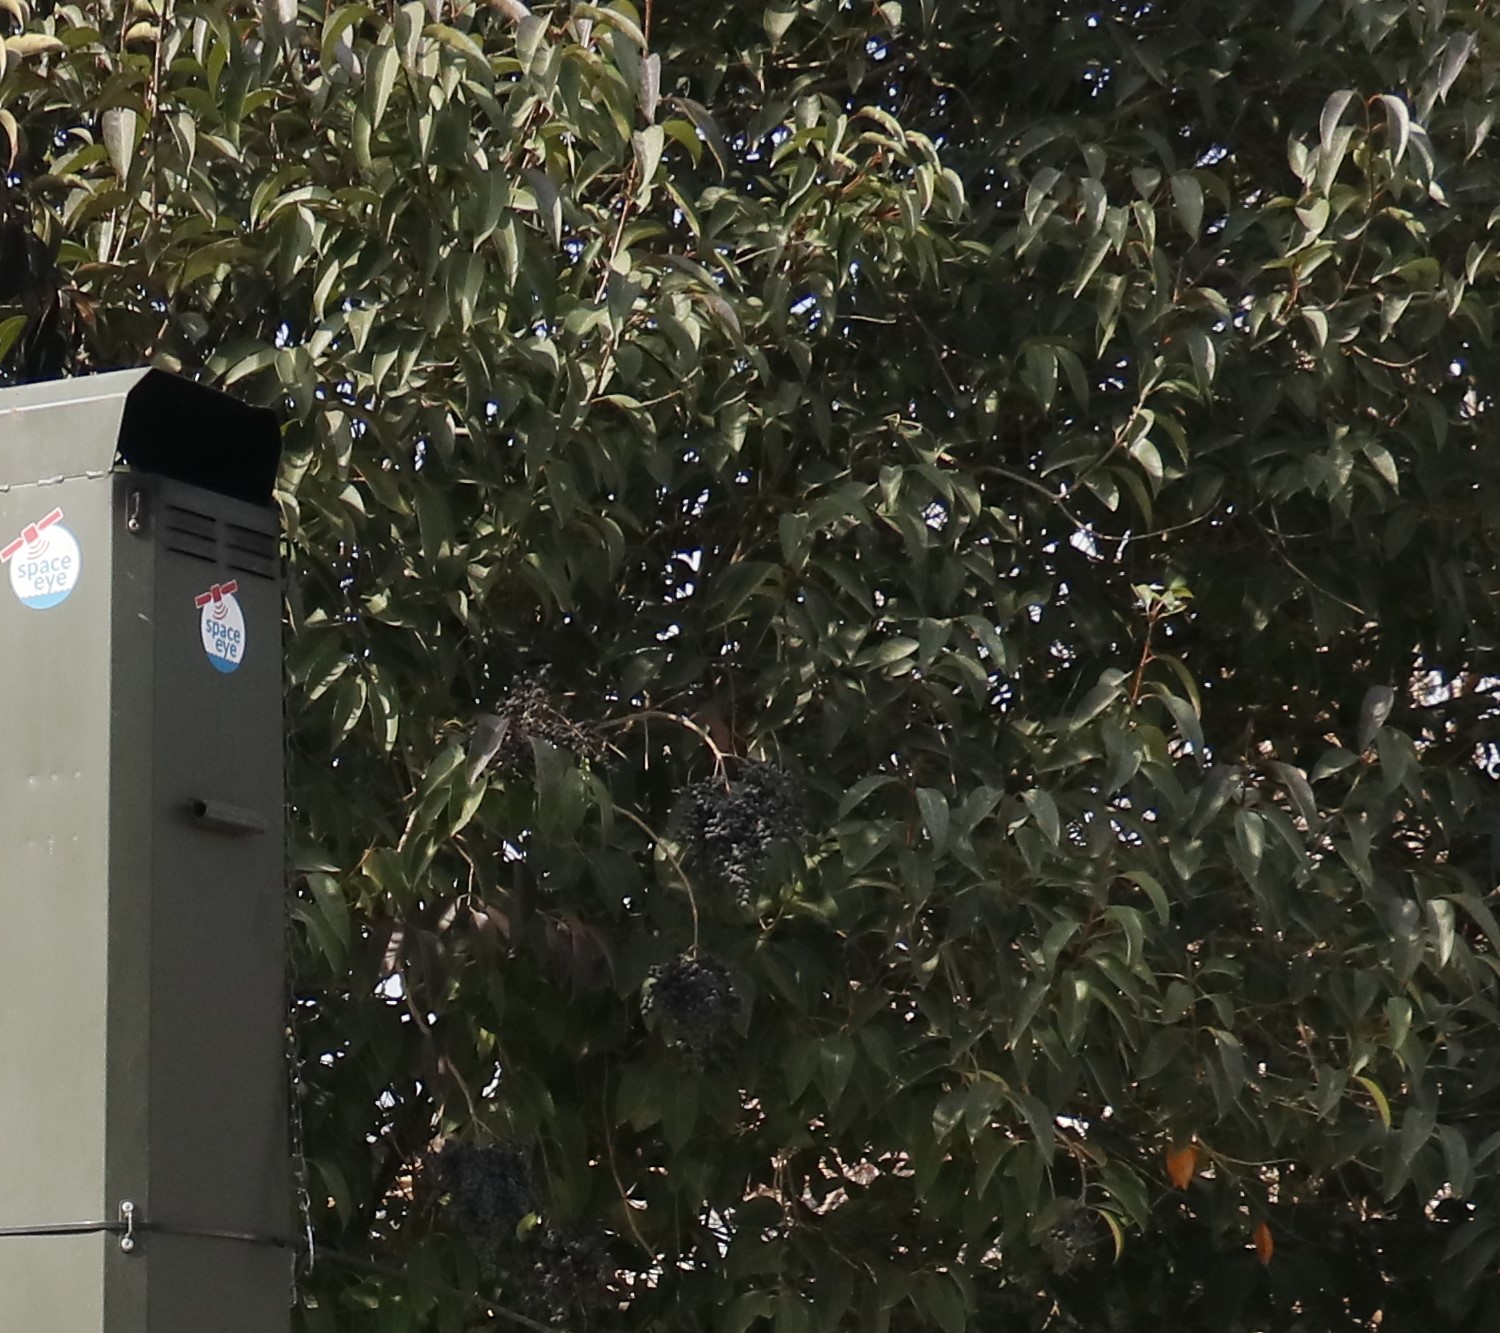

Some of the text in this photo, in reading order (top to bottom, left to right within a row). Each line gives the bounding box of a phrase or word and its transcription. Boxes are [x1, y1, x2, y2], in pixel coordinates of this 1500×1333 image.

[18, 555, 71, 581] space
[34, 572, 67, 593] eye
[206, 619, 240, 643] space
[216, 639, 237, 660] eye
